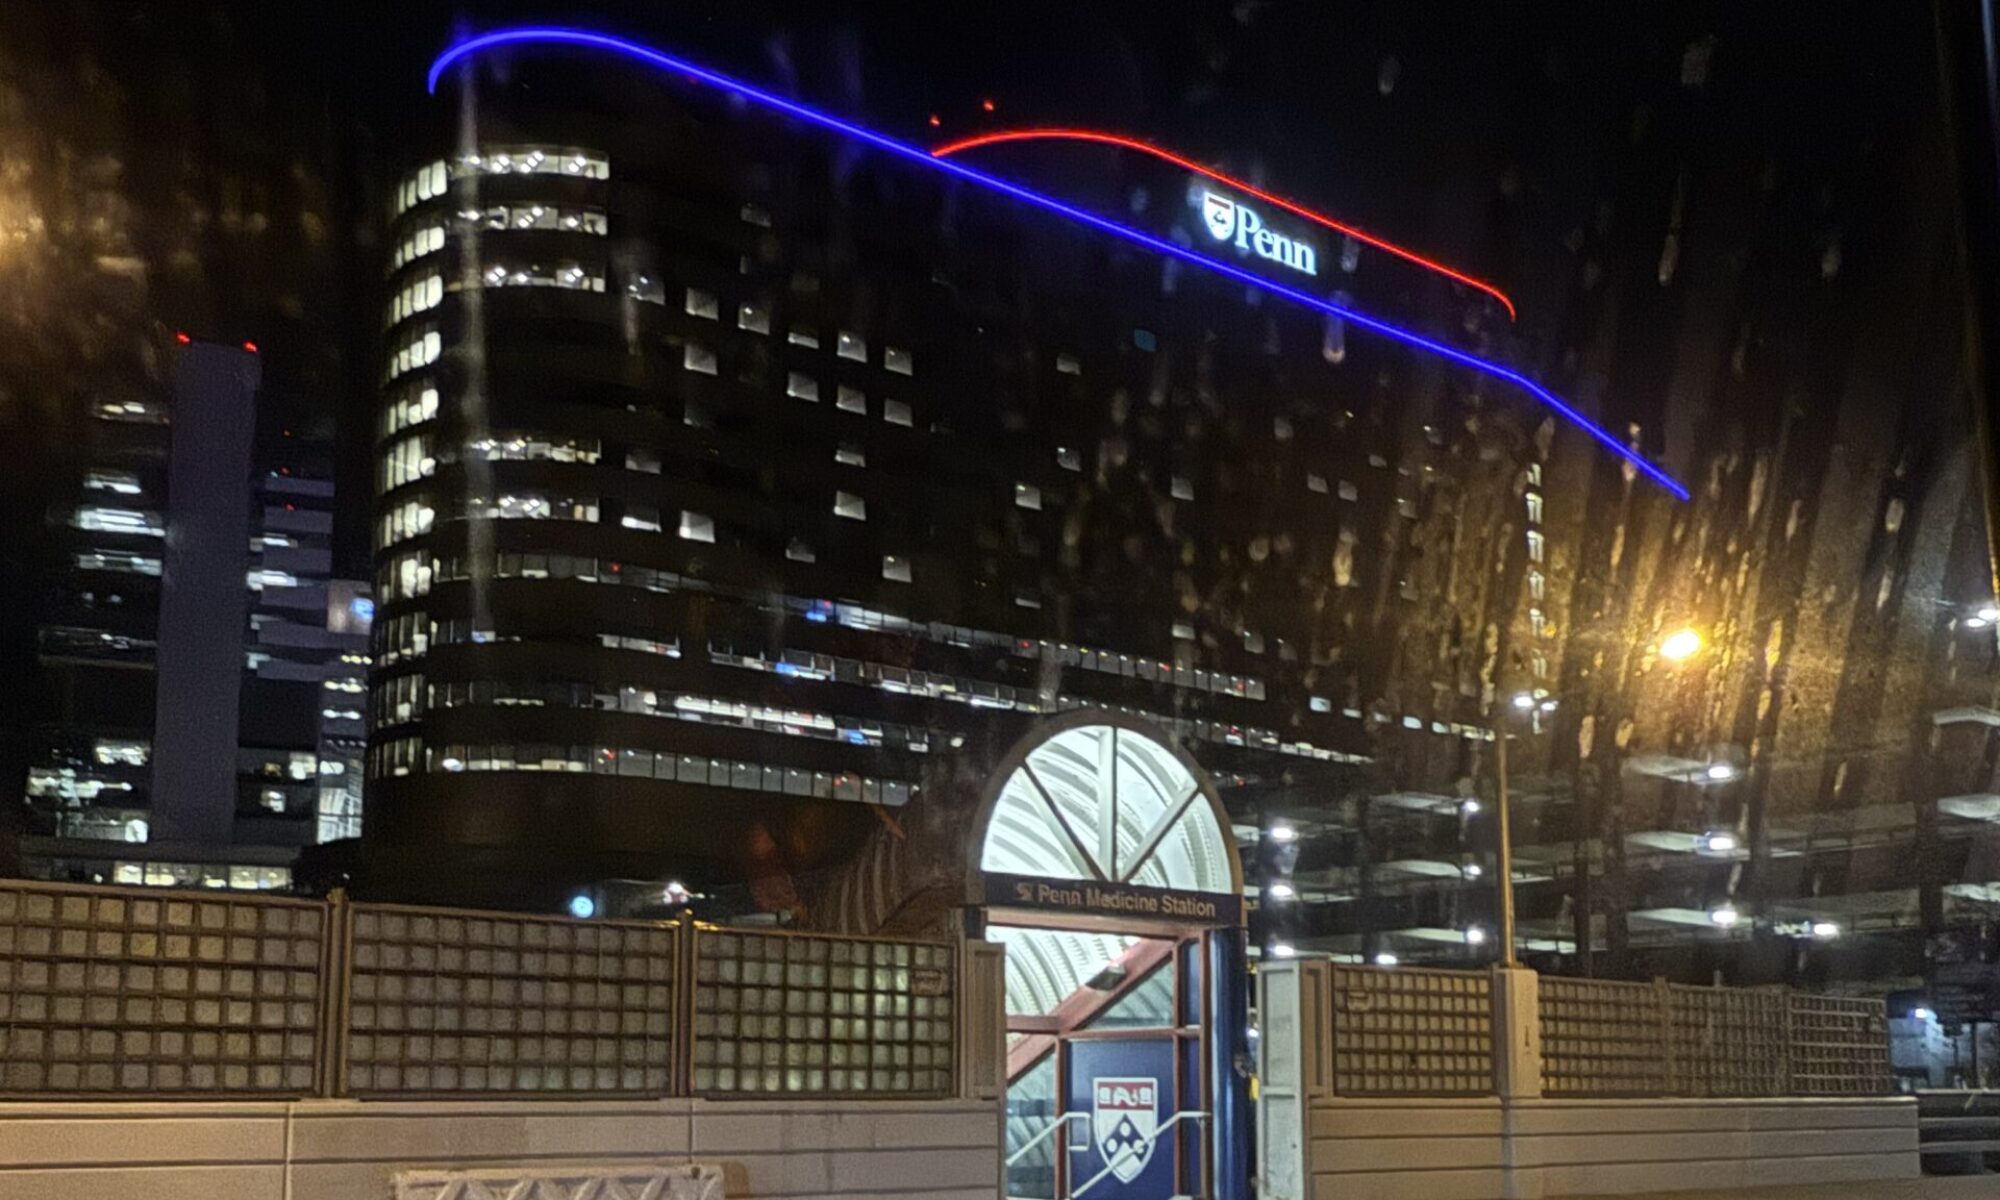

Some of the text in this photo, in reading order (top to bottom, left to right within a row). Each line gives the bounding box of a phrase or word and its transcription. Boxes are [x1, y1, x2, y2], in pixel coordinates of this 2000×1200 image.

[1234, 204, 1317, 276] Penn
[1038, 883, 1215, 917] Penn Medicine Station
